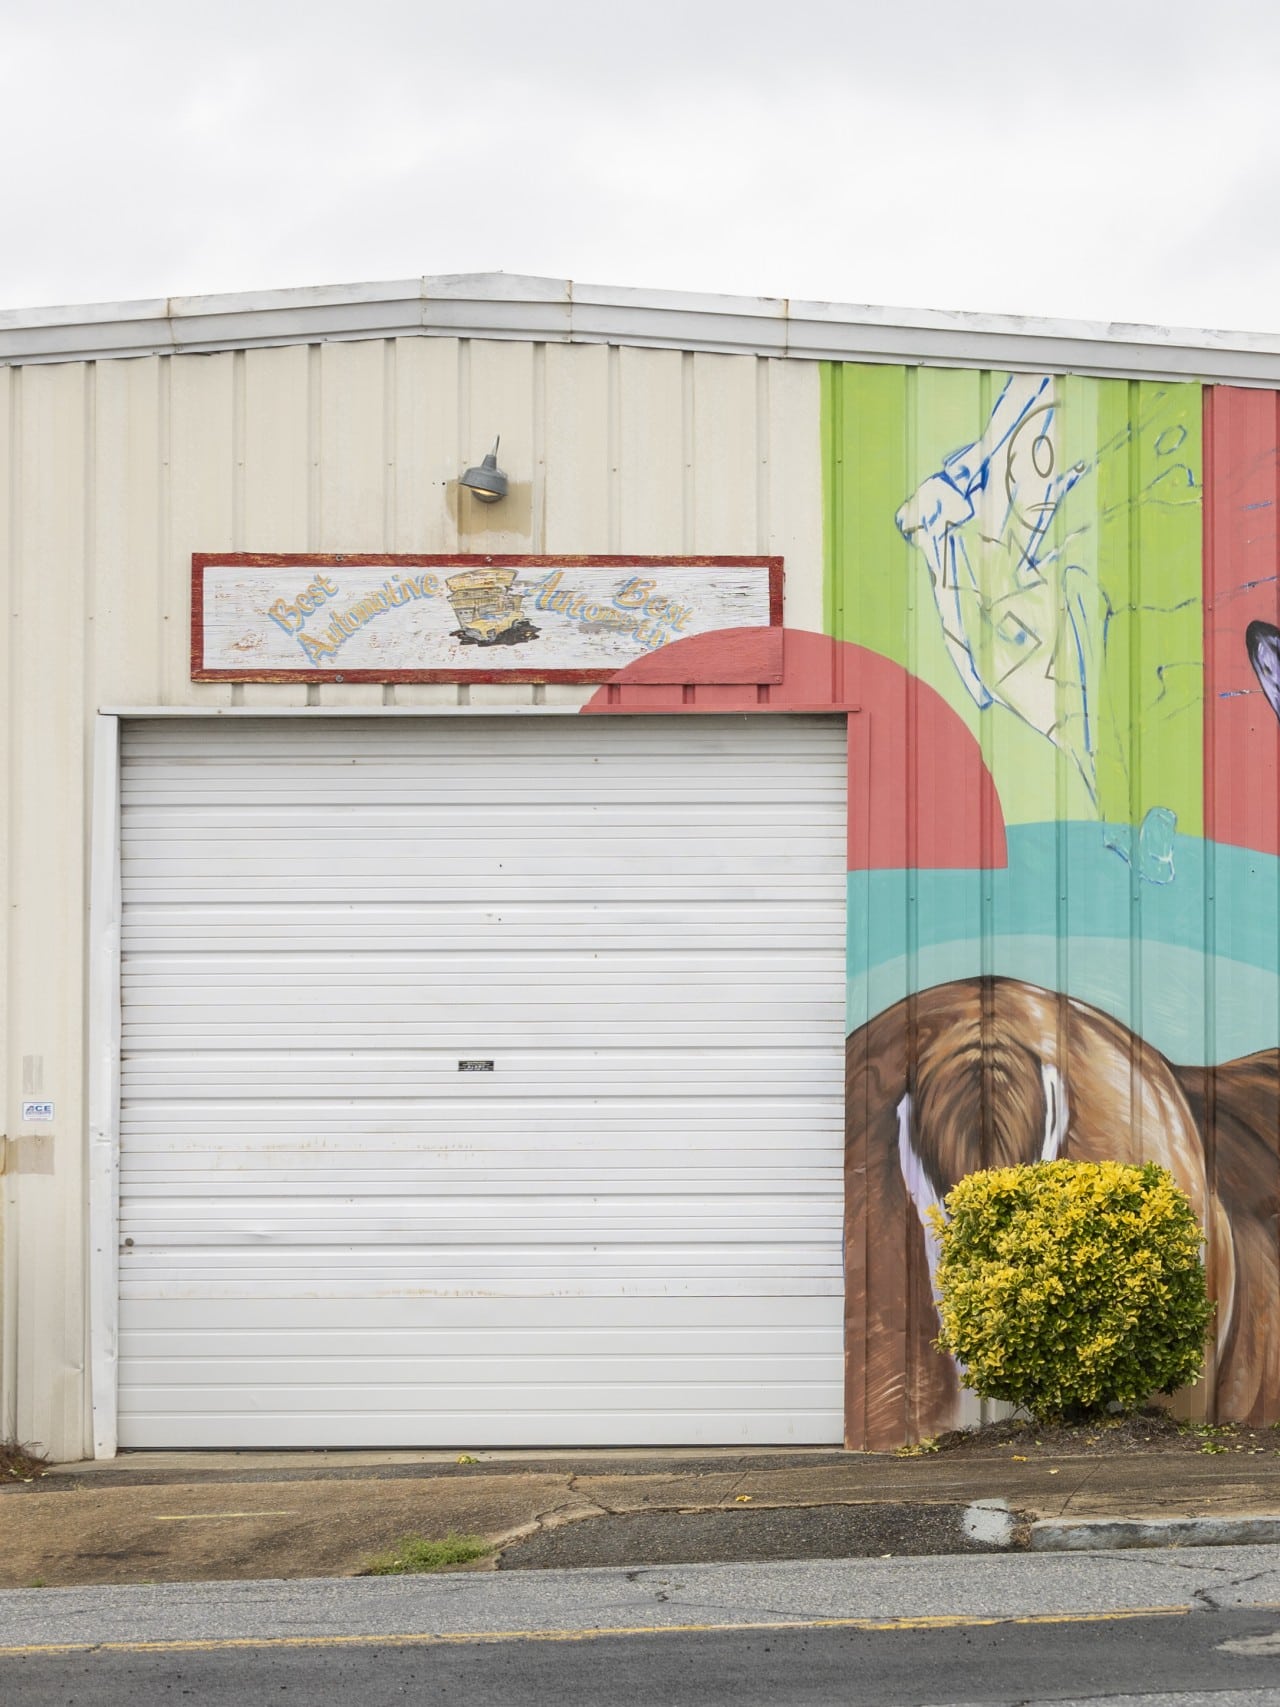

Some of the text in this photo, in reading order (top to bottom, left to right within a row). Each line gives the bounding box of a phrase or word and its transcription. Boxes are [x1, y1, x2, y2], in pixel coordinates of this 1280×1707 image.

[268, 574, 339, 637] Best
[297, 573, 439, 668] Automotive
[612, 576, 692, 632] Best
